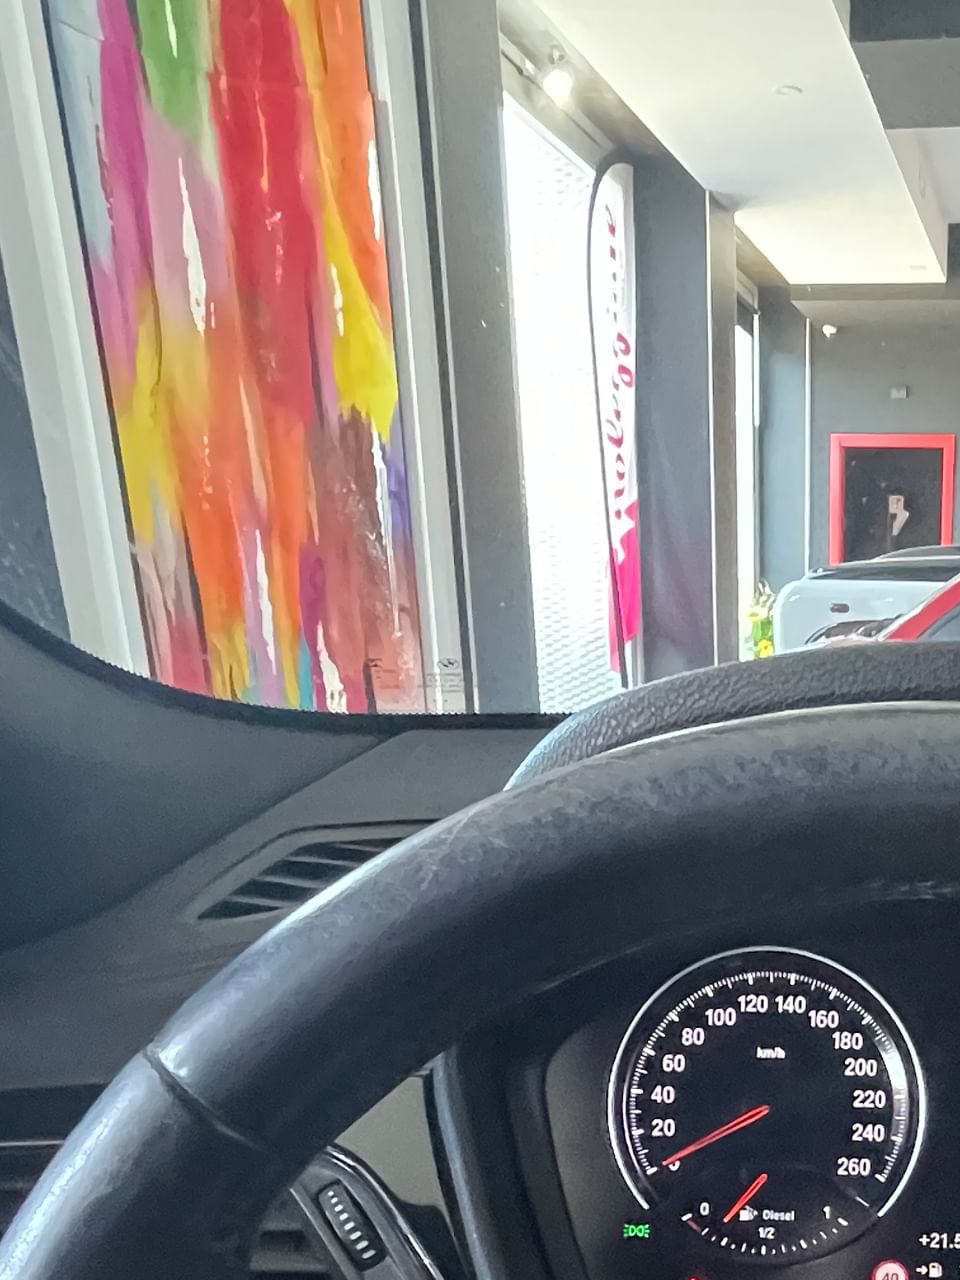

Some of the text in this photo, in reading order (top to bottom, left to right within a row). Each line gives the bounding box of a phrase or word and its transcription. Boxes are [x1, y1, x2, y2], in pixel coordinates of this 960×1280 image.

[737, 994, 769, 1014] 120
[774, 995, 807, 1015] 140
[704, 1007, 737, 1027] 100
[807, 1009, 840, 1029] 160
[681, 1027, 705, 1047] 80
[831, 1030, 864, 1051] 180
[756, 1046, 786, 1059] km/h
[662, 1053, 686, 1073] 60
[844, 1057, 878, 1077] 200
[650, 1084, 676, 1104] 40
[852, 1089, 887, 1109] 220
[651, 1118, 676, 1137] 20
[851, 1122, 886, 1143] 240
[836, 1156, 871, 1177] 260
[699, 1201, 710, 1216] 0
[762, 1209, 795, 1222] Diesel
[823, 1205, 831, 1220] 1
[758, 1226, 776, 1240] 1/2
